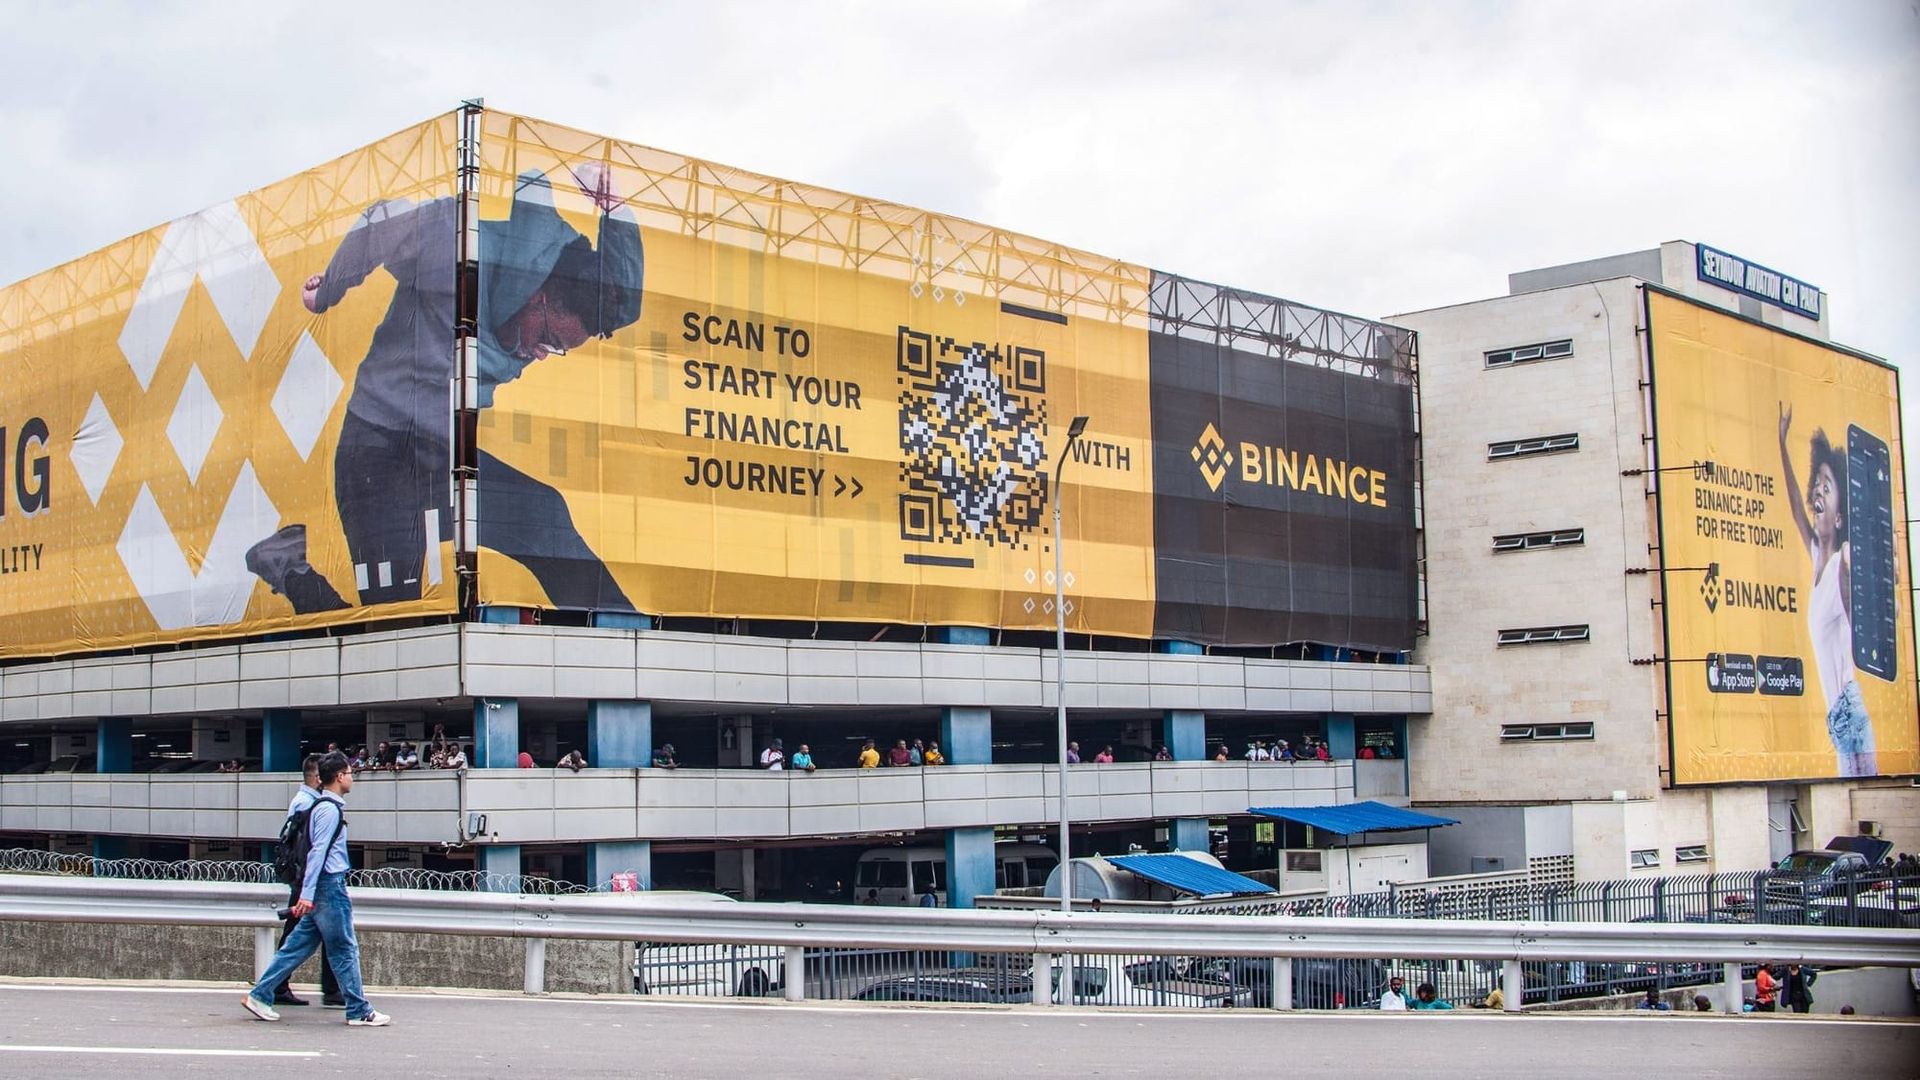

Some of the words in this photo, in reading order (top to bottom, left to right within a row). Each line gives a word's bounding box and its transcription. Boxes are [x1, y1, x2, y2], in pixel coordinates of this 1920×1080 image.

[1703, 249, 1745, 288] SEYMOUR
[1745, 264, 1781, 300] AVIATION
[1782, 278, 1798, 307] CAR
[1799, 284, 1819, 314] PARK
[682, 312, 764, 352] SCAN
[774, 326, 810, 358] TO
[684, 360, 777, 399] START
[785, 374, 861, 410] YOUR
[685, 407, 849, 453] FINANCIAL
[1070, 439, 1130, 471] WITH
[684, 456, 825, 496] JOURNEY
[1239, 441, 1387, 507] BINANCE
[1754, 474, 1774, 496] THE
[1695, 488, 1743, 516] BINANCE
[1745, 500, 1765, 520] APP
[1696, 515, 1718, 539] FOR
[1720, 520, 1746, 543] FREE
[1748, 525, 1784, 550] TODAY!
[1724, 579, 1797, 613] BINANCE
[1722, 672, 1736, 690] App
[1737, 672, 1755, 688] Store
[1766, 673, 1789, 691] Google
[1790, 674, 1803, 691] Play
